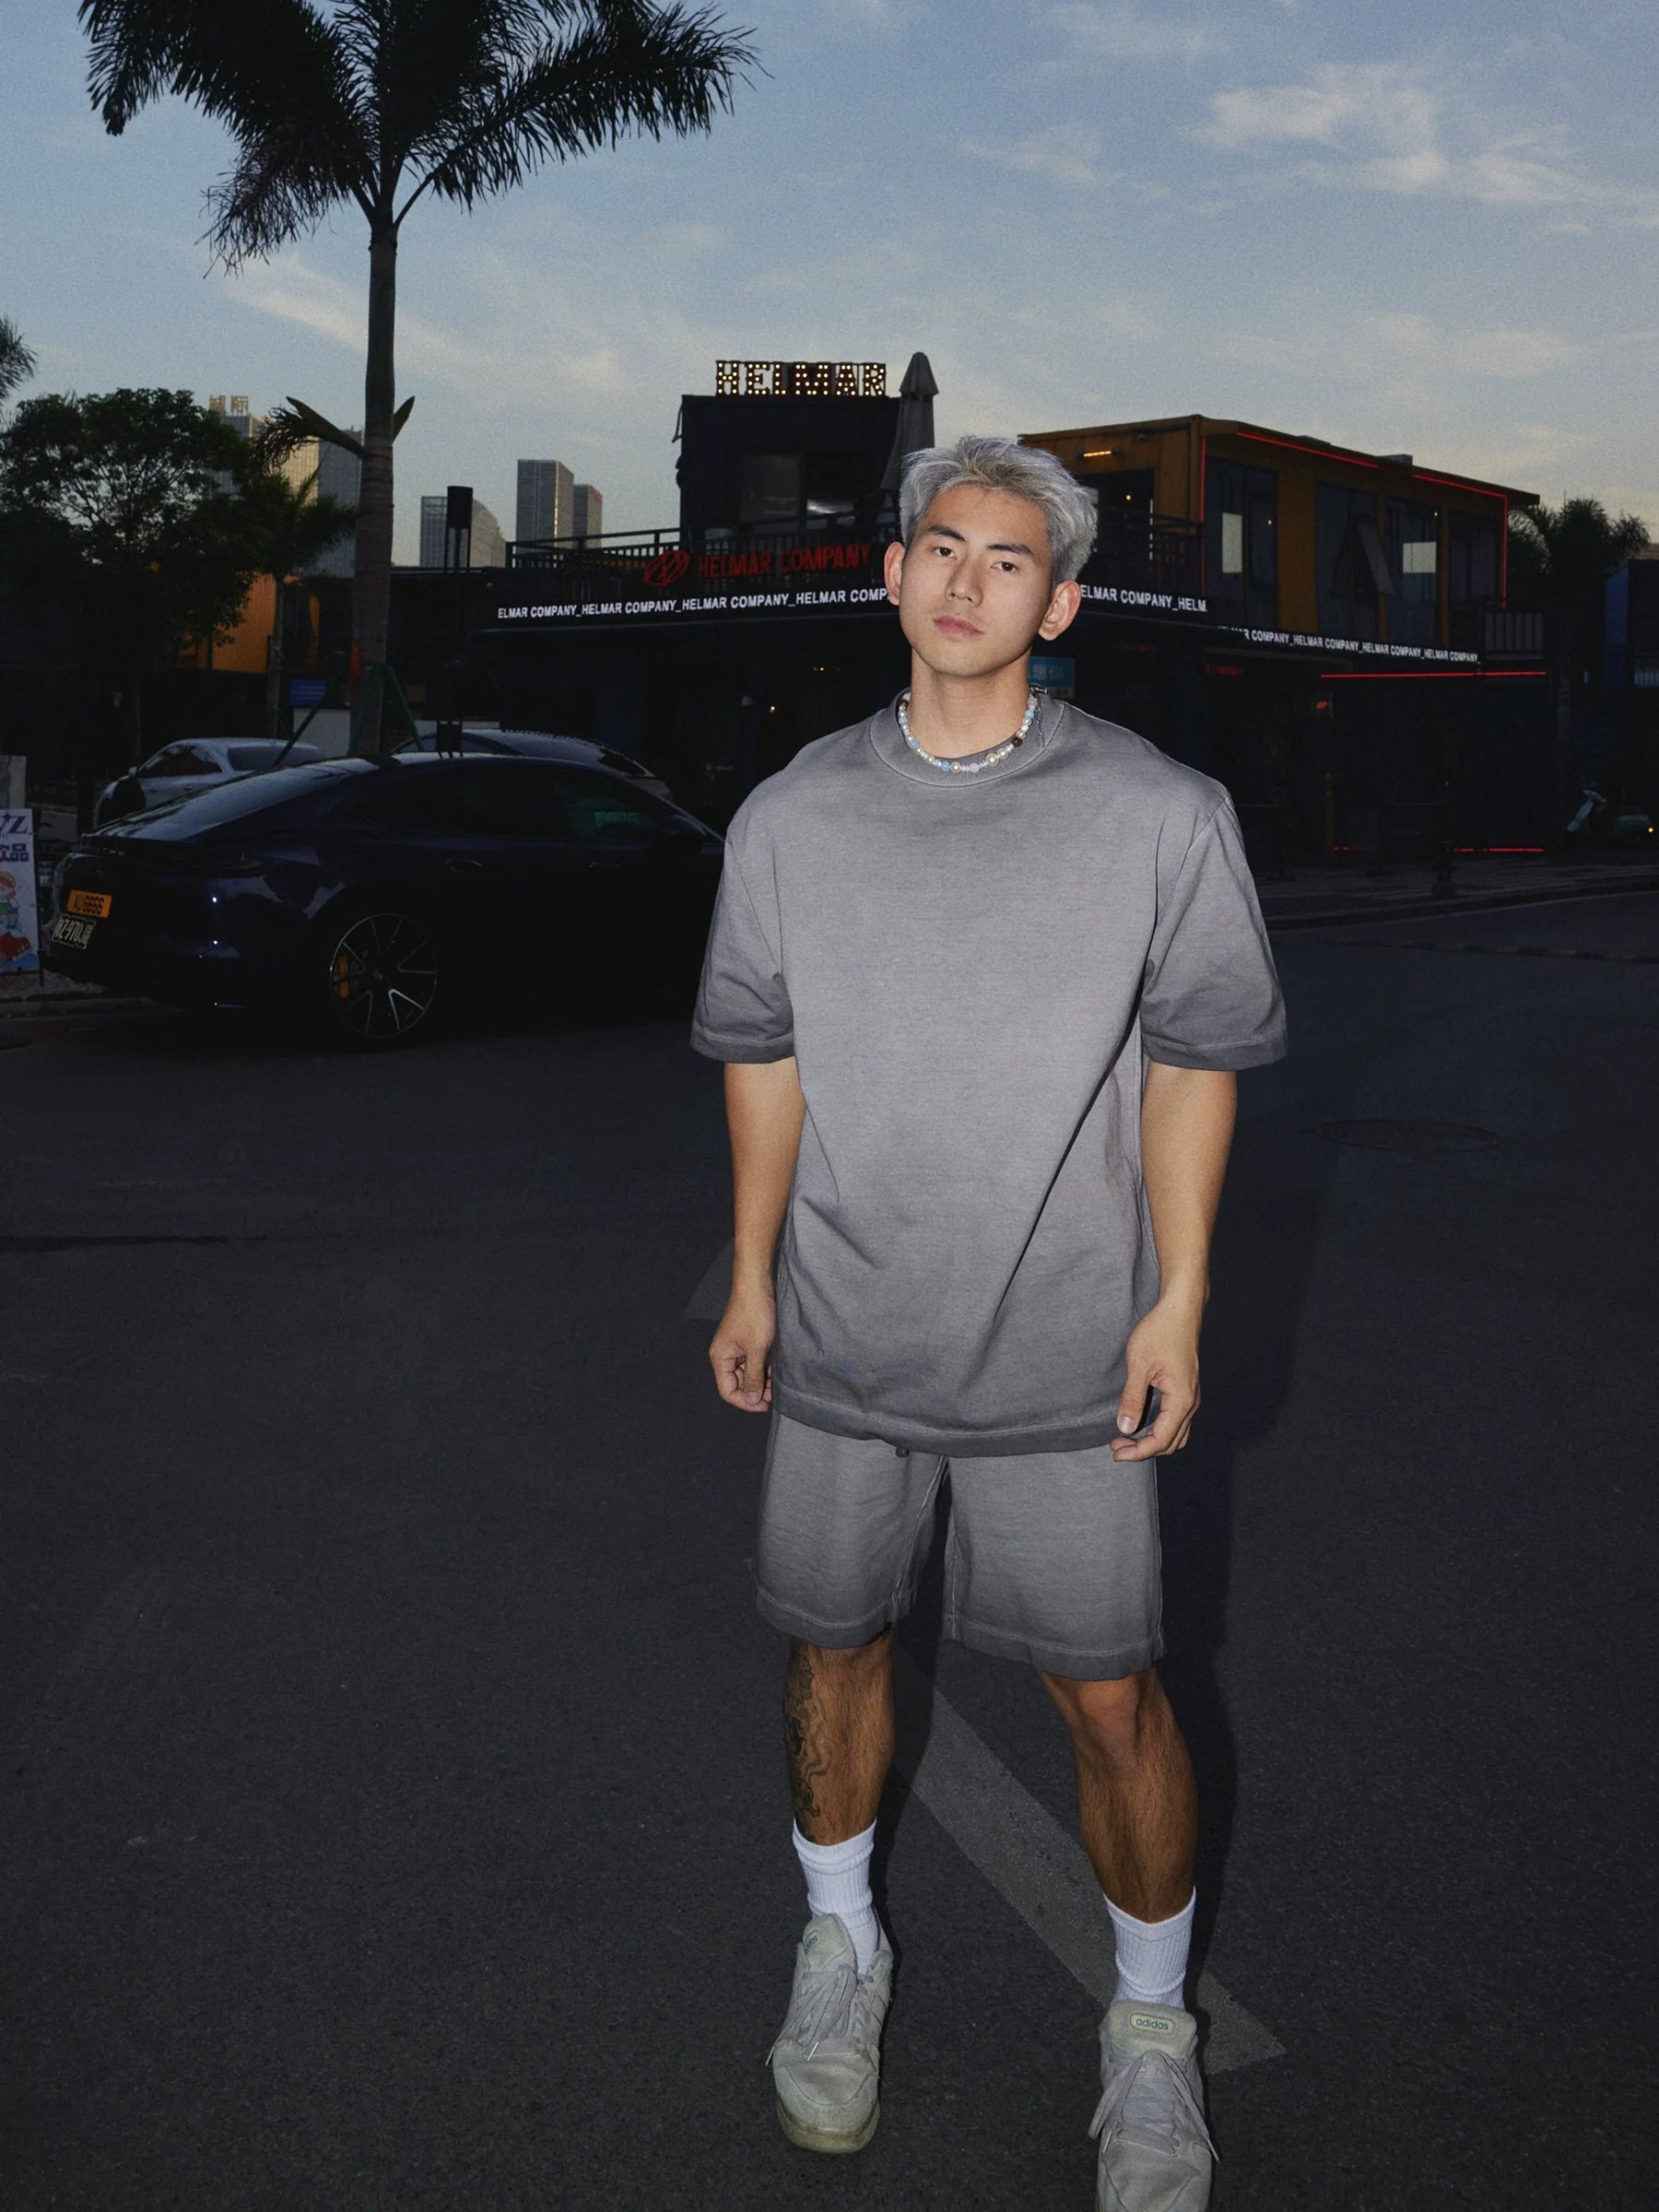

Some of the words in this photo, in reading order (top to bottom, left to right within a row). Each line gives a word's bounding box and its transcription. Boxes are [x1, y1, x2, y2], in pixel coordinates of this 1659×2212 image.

[716, 360, 887, 397] HELMAR
[698, 553, 772, 579] HELMAR
[779, 543, 872, 572] COMPANY
[850, 587, 890, 604] COMP
[1135, 2018, 1170, 2030] adidas
